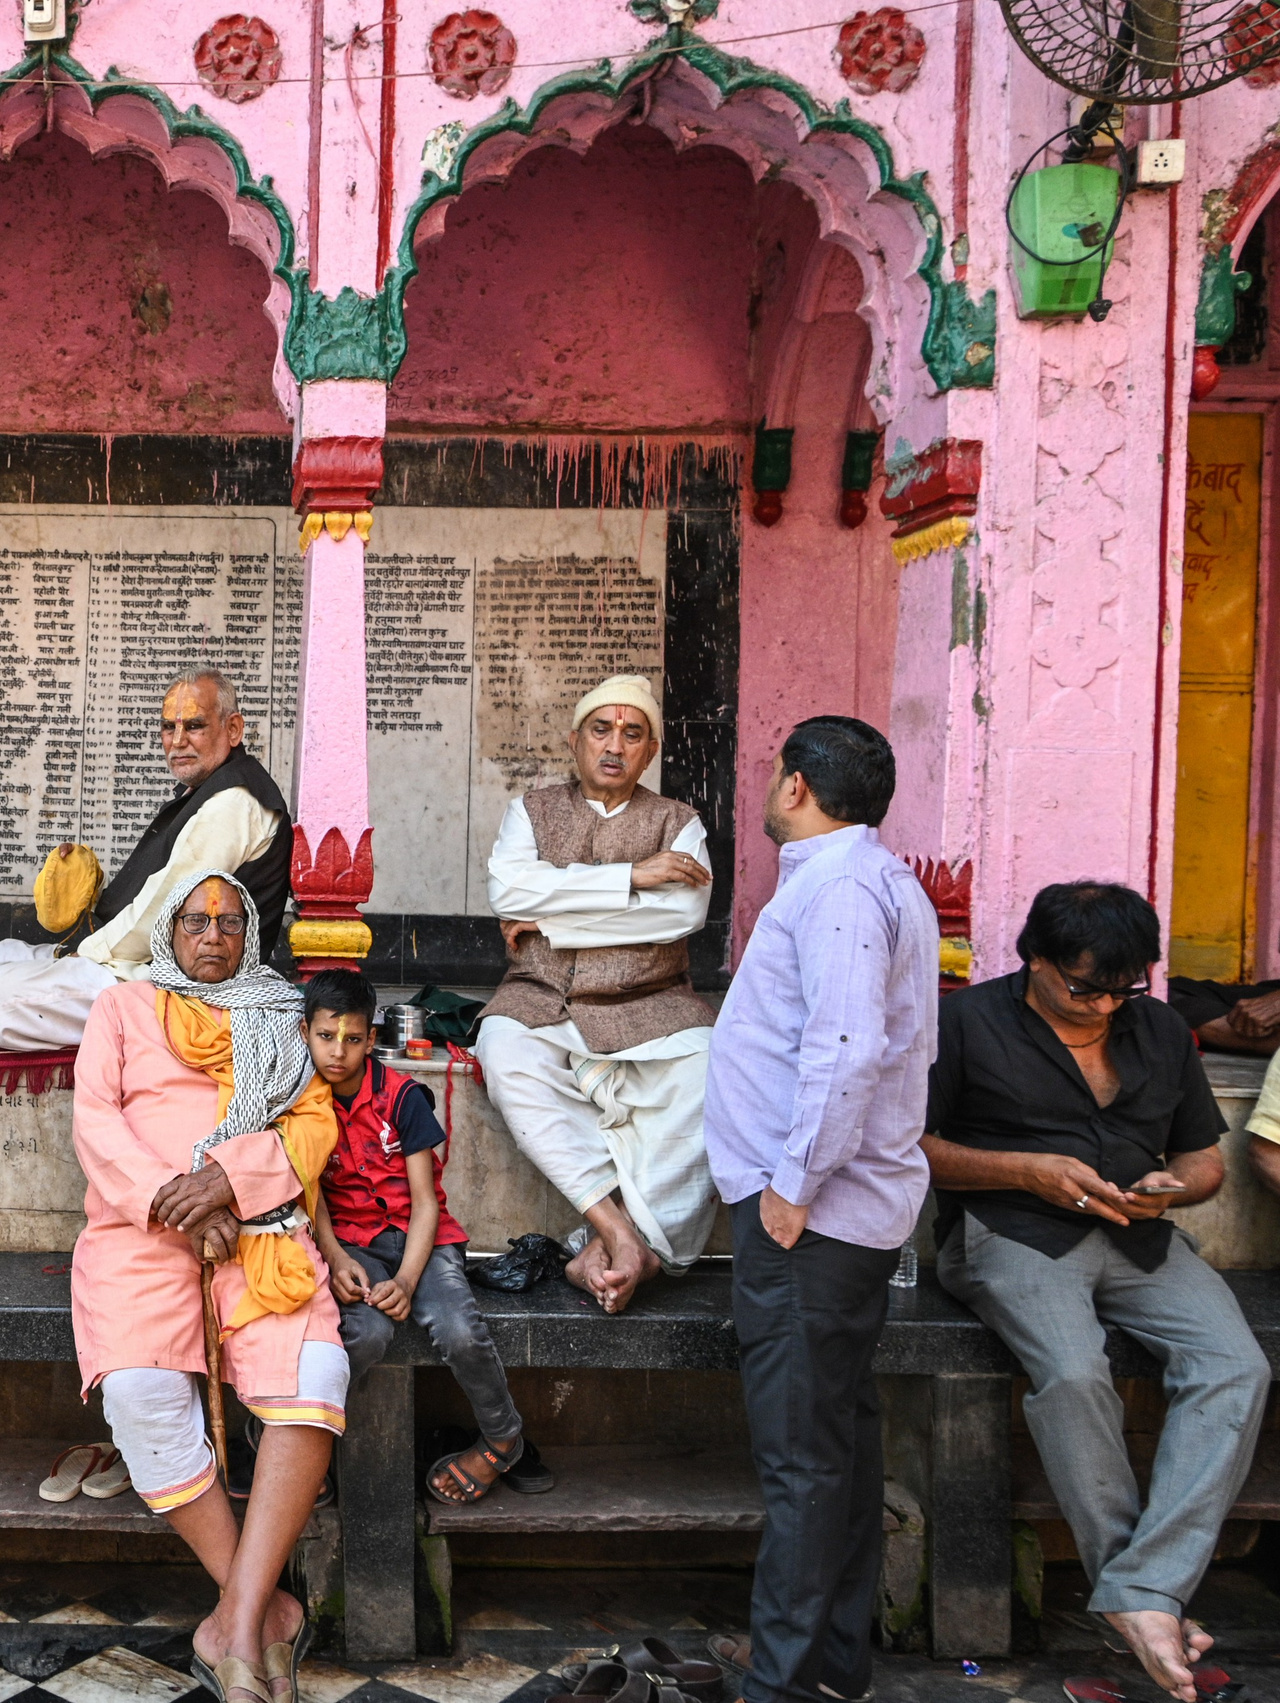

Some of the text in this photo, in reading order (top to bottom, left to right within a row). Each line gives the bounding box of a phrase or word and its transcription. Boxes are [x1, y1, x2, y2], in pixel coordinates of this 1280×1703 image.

[449, 581, 465, 589] घाट
[375, 614, 422, 627] हनुमान गली
[449, 642, 465, 650] घाट
[397, 697, 414, 707] गली
[425, 721, 443, 731] गली
